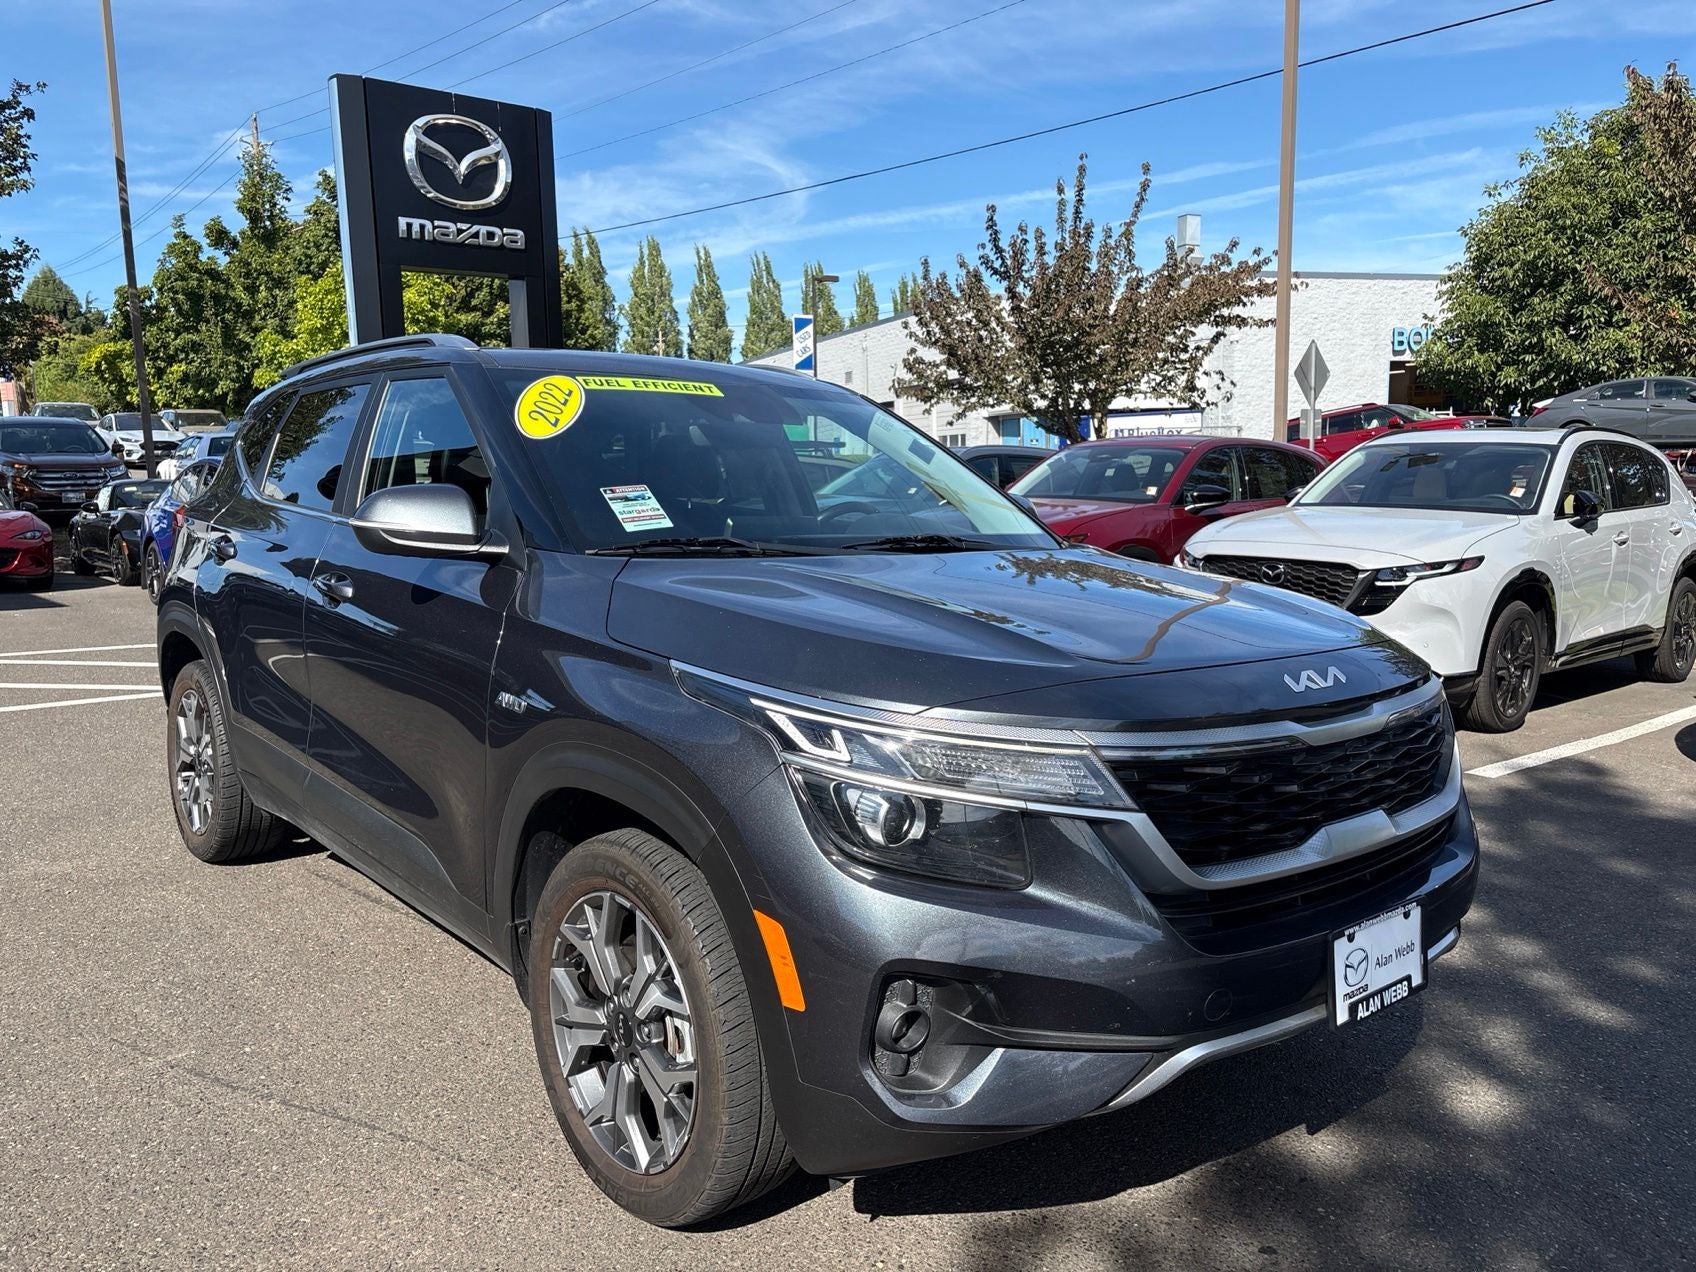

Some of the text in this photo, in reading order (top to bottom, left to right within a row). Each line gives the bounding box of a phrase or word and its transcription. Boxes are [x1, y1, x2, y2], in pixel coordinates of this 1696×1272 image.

[398, 216, 526, 249] mazda
[1393, 326, 1435, 351] BO
[582, 378, 715, 394] FUEL EFFICIENT
[528, 382, 573, 428] 2022
[1283, 666, 1347, 693] KIA
[495, 691, 527, 713] AWD
[1374, 939, 1415, 971] Alan Webb
[1357, 980, 1409, 1021] ALAN WEBB
